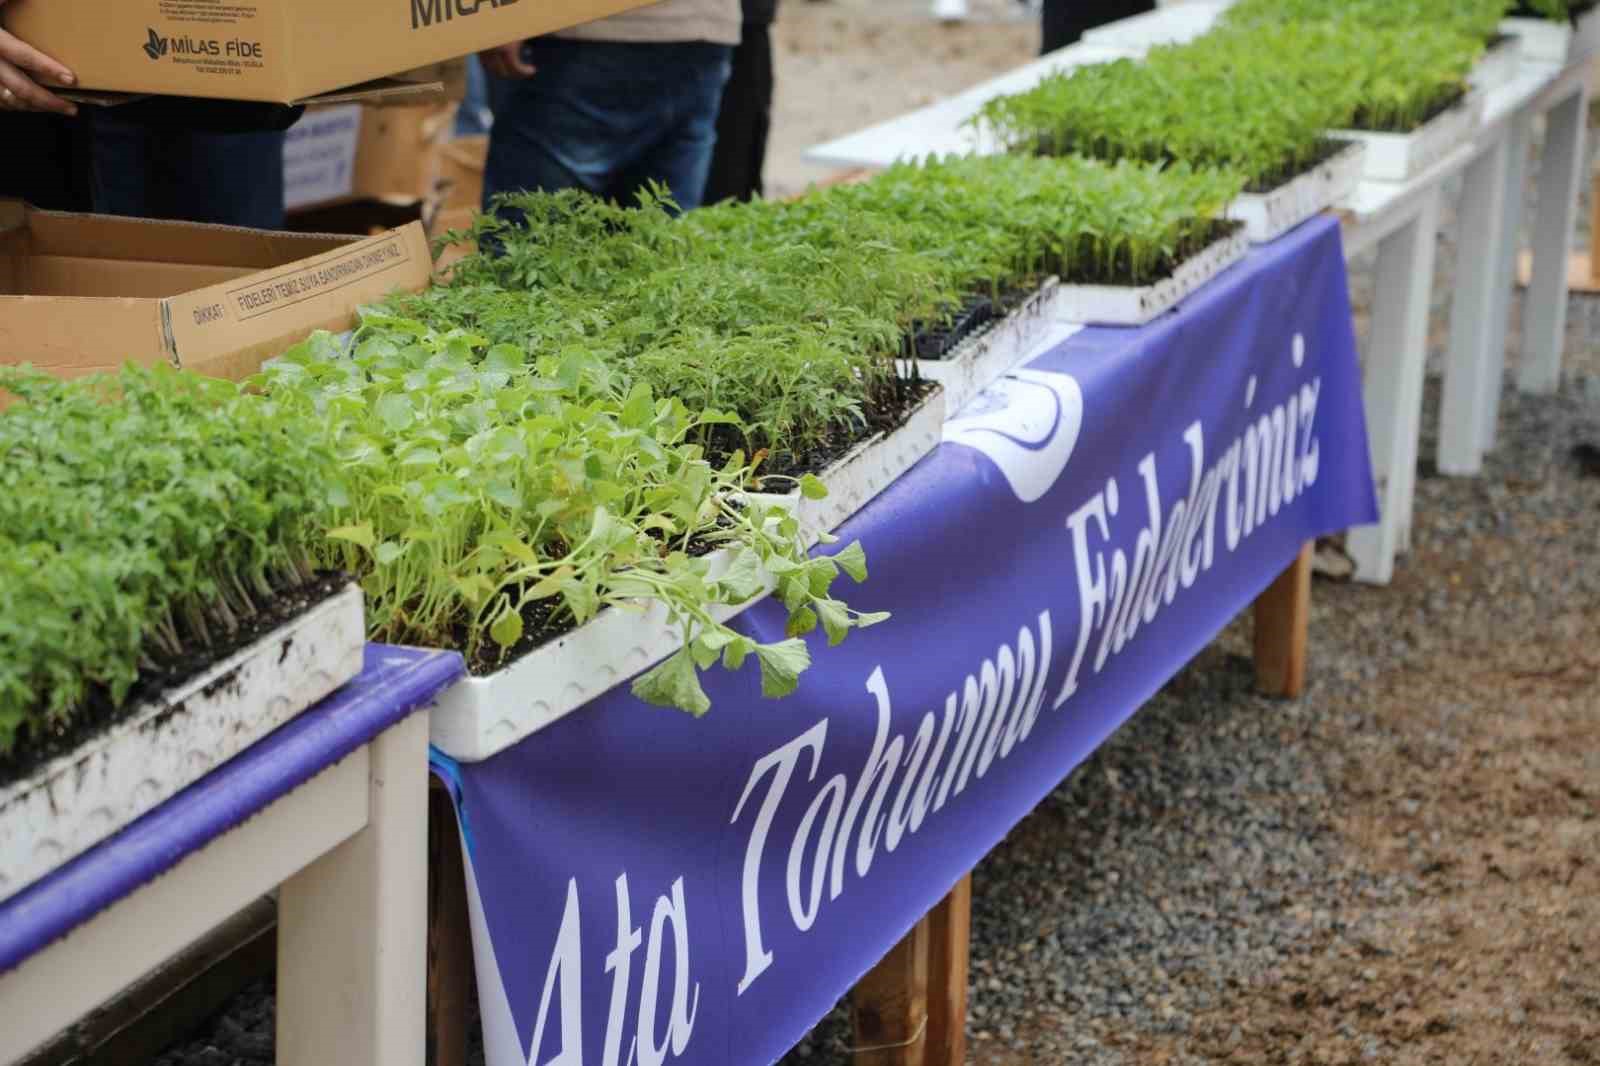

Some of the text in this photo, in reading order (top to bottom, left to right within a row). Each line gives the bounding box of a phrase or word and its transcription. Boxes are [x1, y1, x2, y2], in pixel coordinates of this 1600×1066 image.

[171, 35, 263, 58] MİLAS FİDE
[528, 333, 1321, 1066] Ata Tohumu Fidelerimiz
